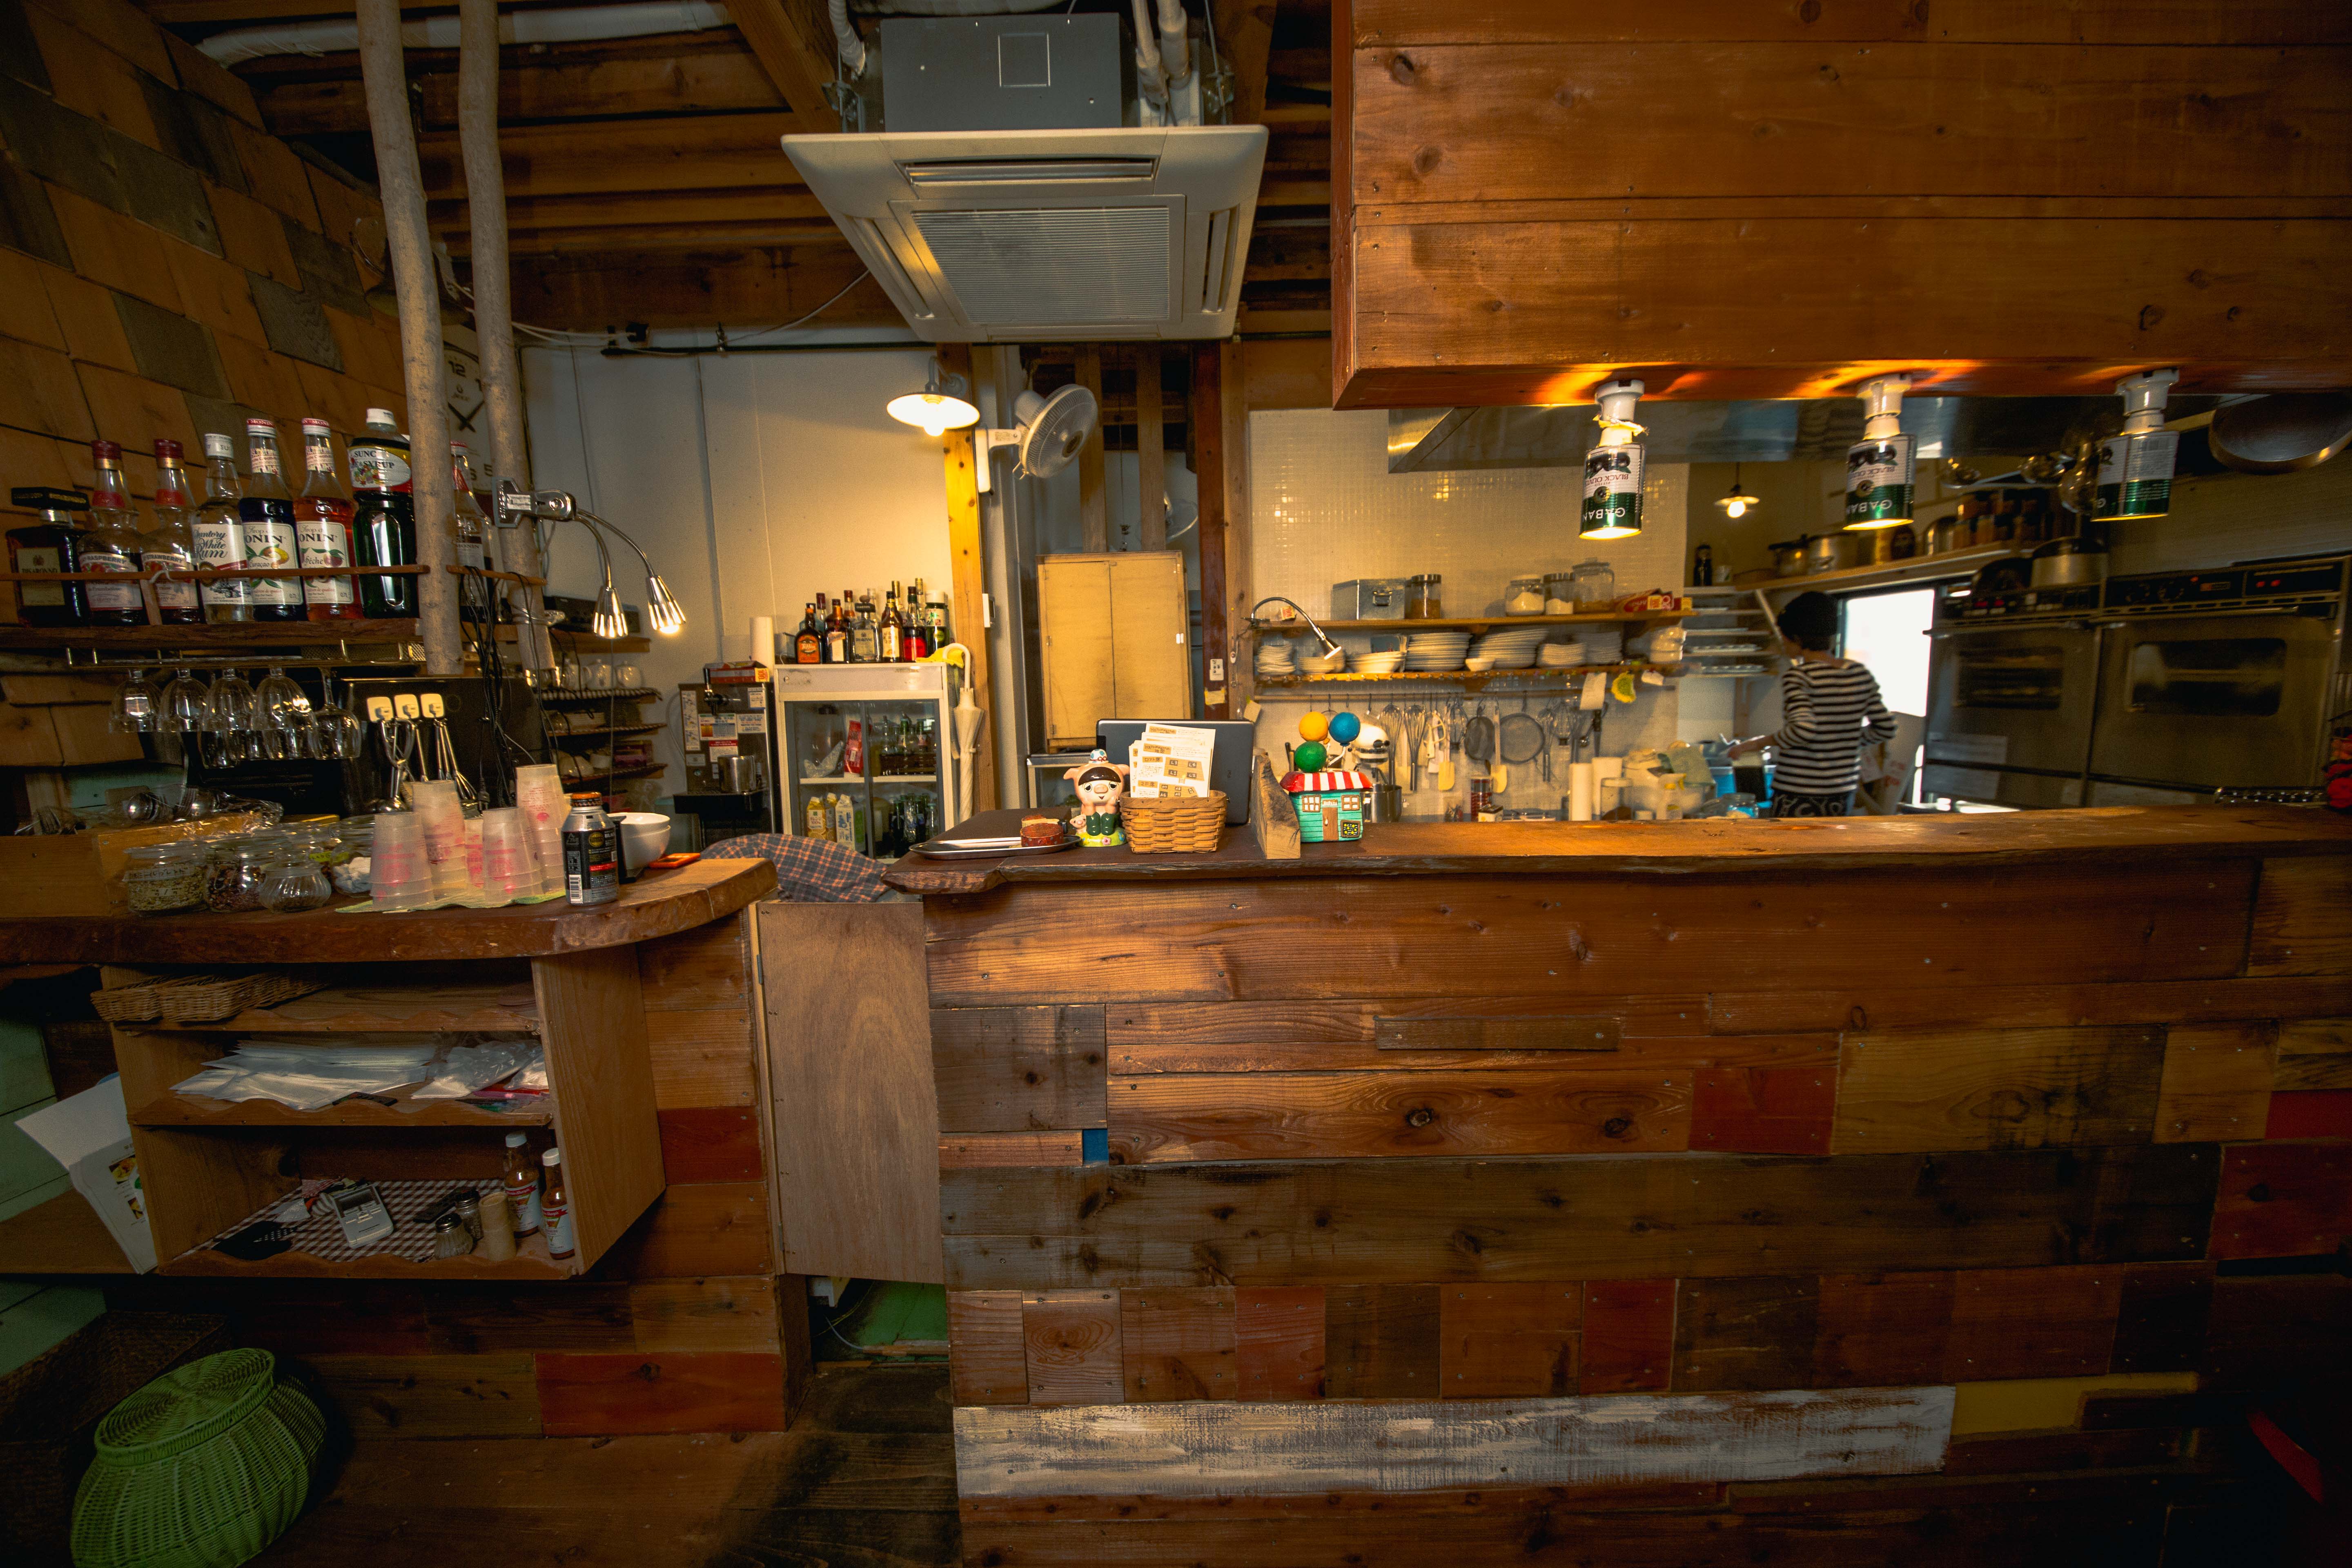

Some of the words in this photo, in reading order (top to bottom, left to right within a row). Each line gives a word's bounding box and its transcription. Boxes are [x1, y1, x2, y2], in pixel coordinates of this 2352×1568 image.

[448, 361, 466, 377] 12
[244, 534, 283, 543] ONIN
[298, 533, 335, 543] ONIN
[196, 538, 226, 549] White
[196, 547, 228, 560] Rum
[86, 555, 127, 564] RASPBERRY
[146, 555, 183, 563] STRAWBERRY
